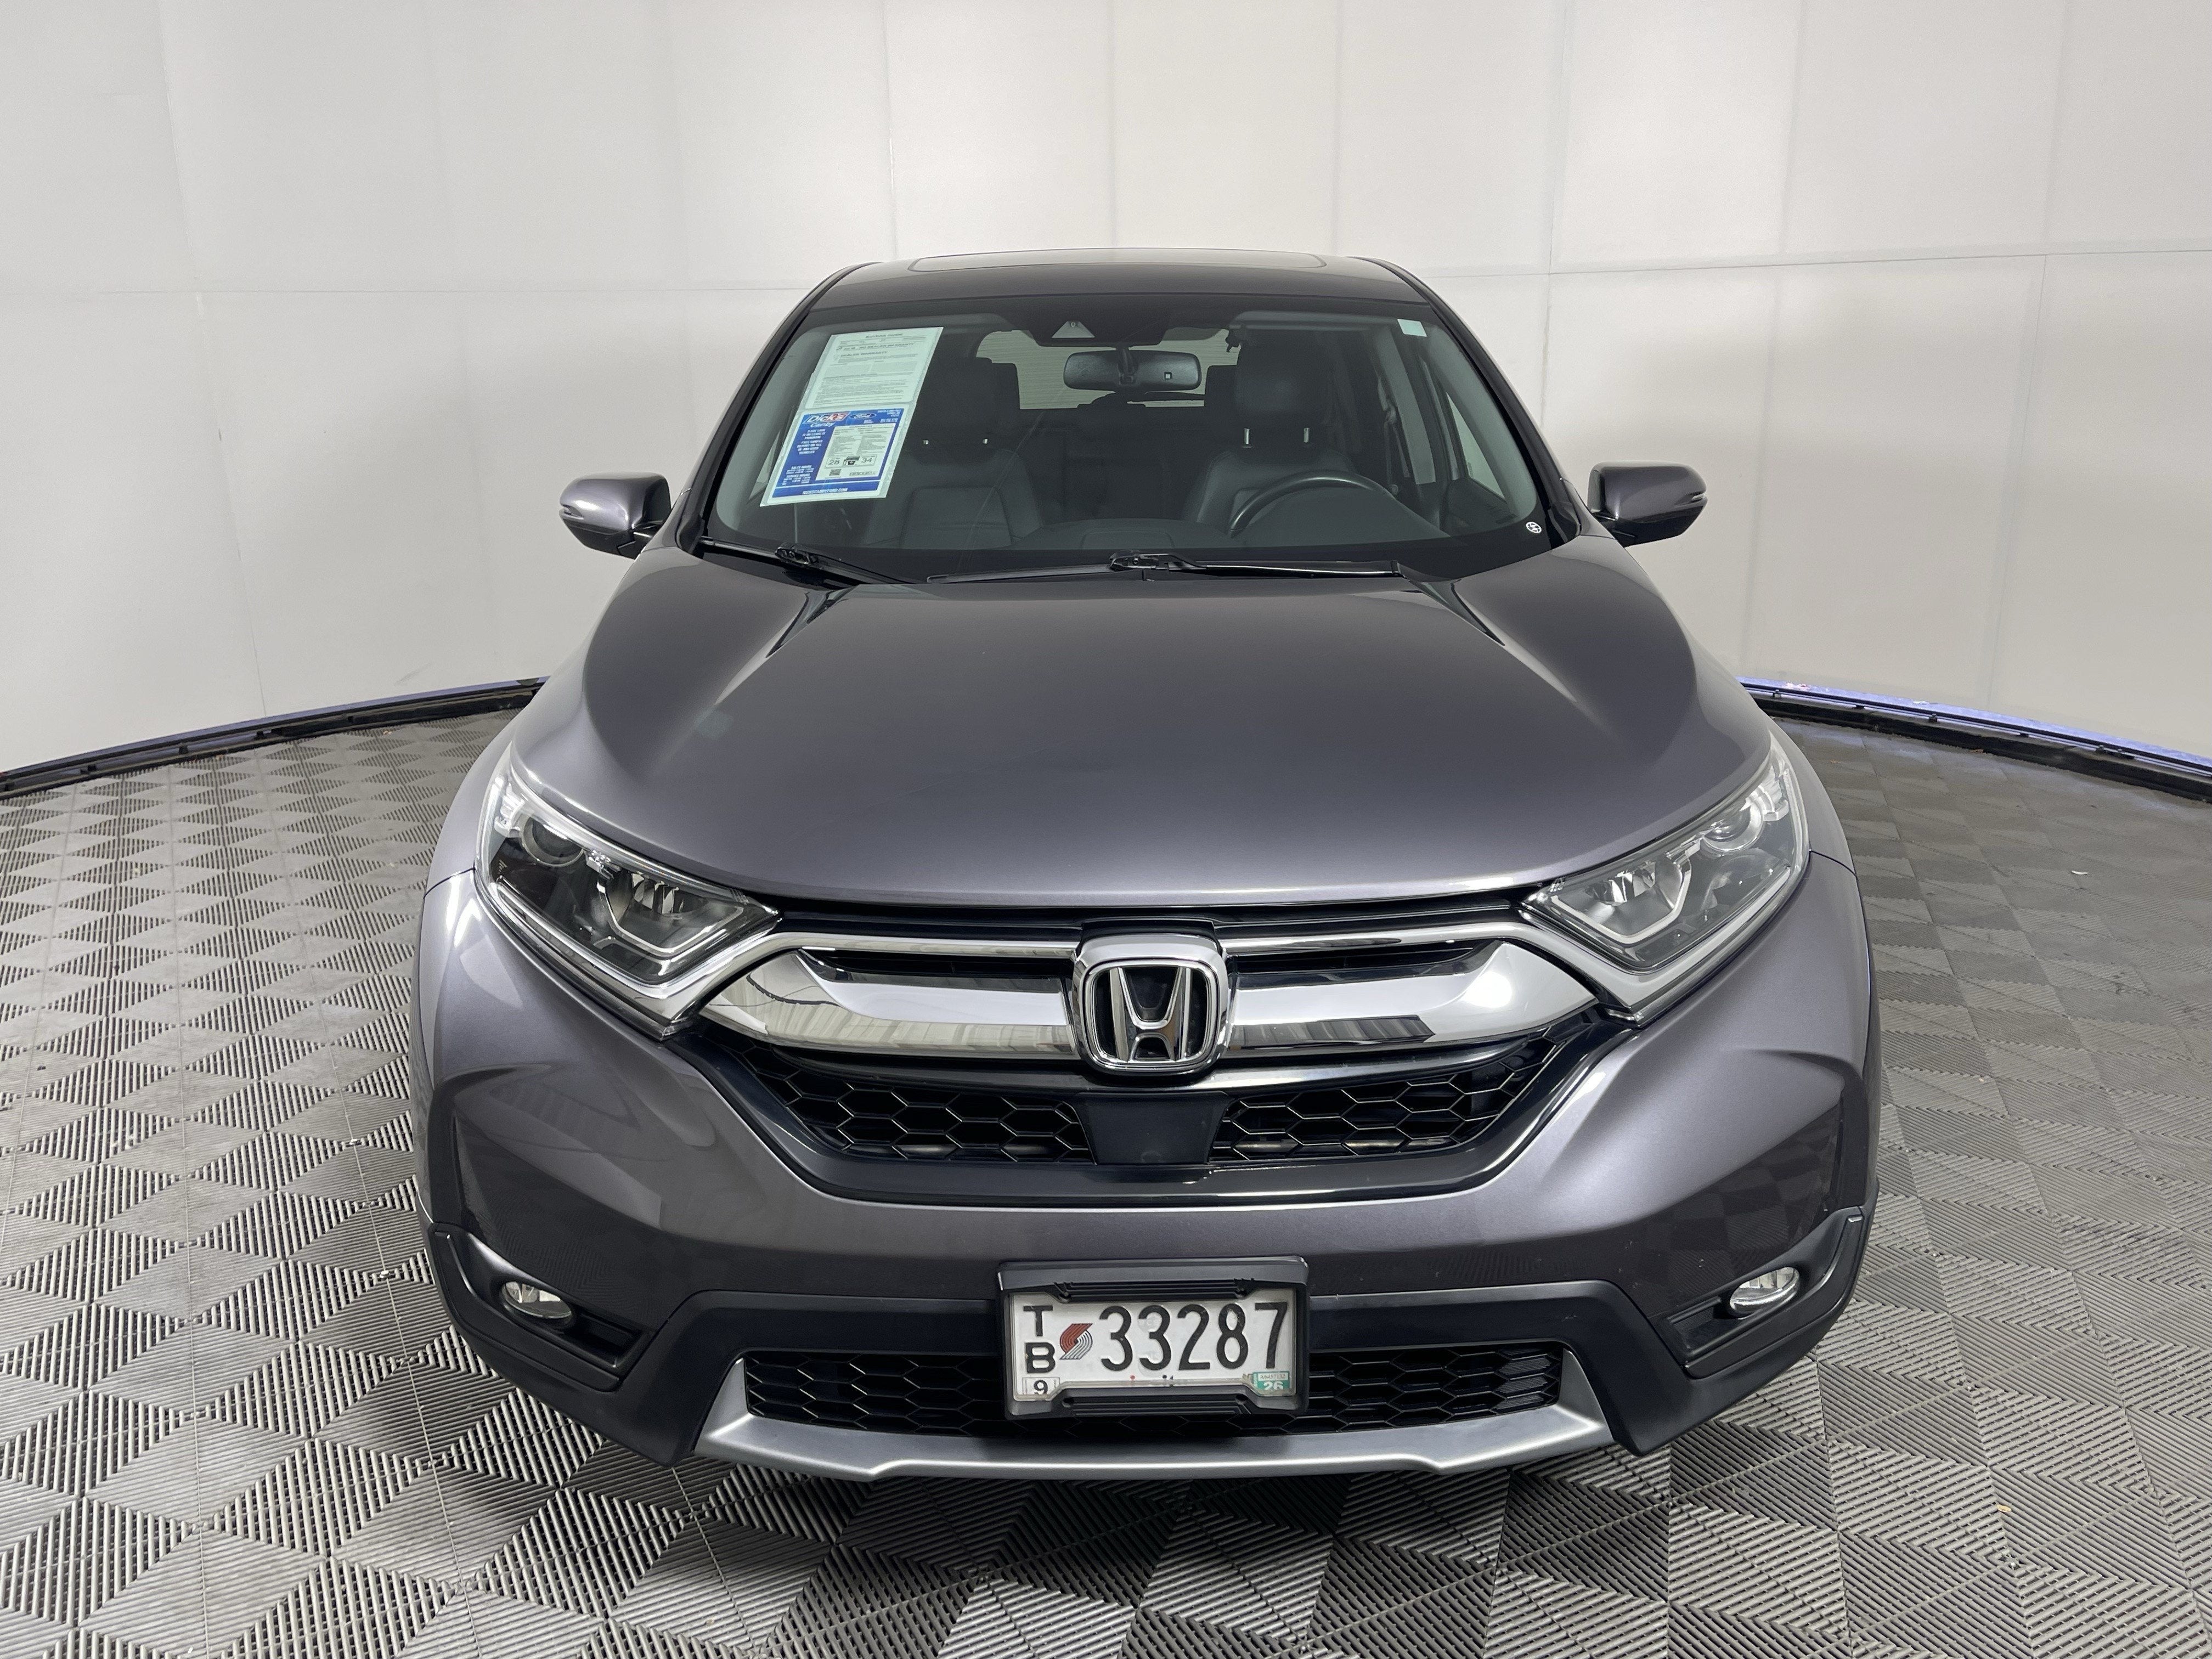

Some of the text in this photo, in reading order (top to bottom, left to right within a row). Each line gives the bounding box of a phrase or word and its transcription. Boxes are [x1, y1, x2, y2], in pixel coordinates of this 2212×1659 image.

[1098, 1301, 1288, 1372] 33287
[1034, 1379, 1048, 1395] 9
[1263, 1381, 1284, 1390] 26
